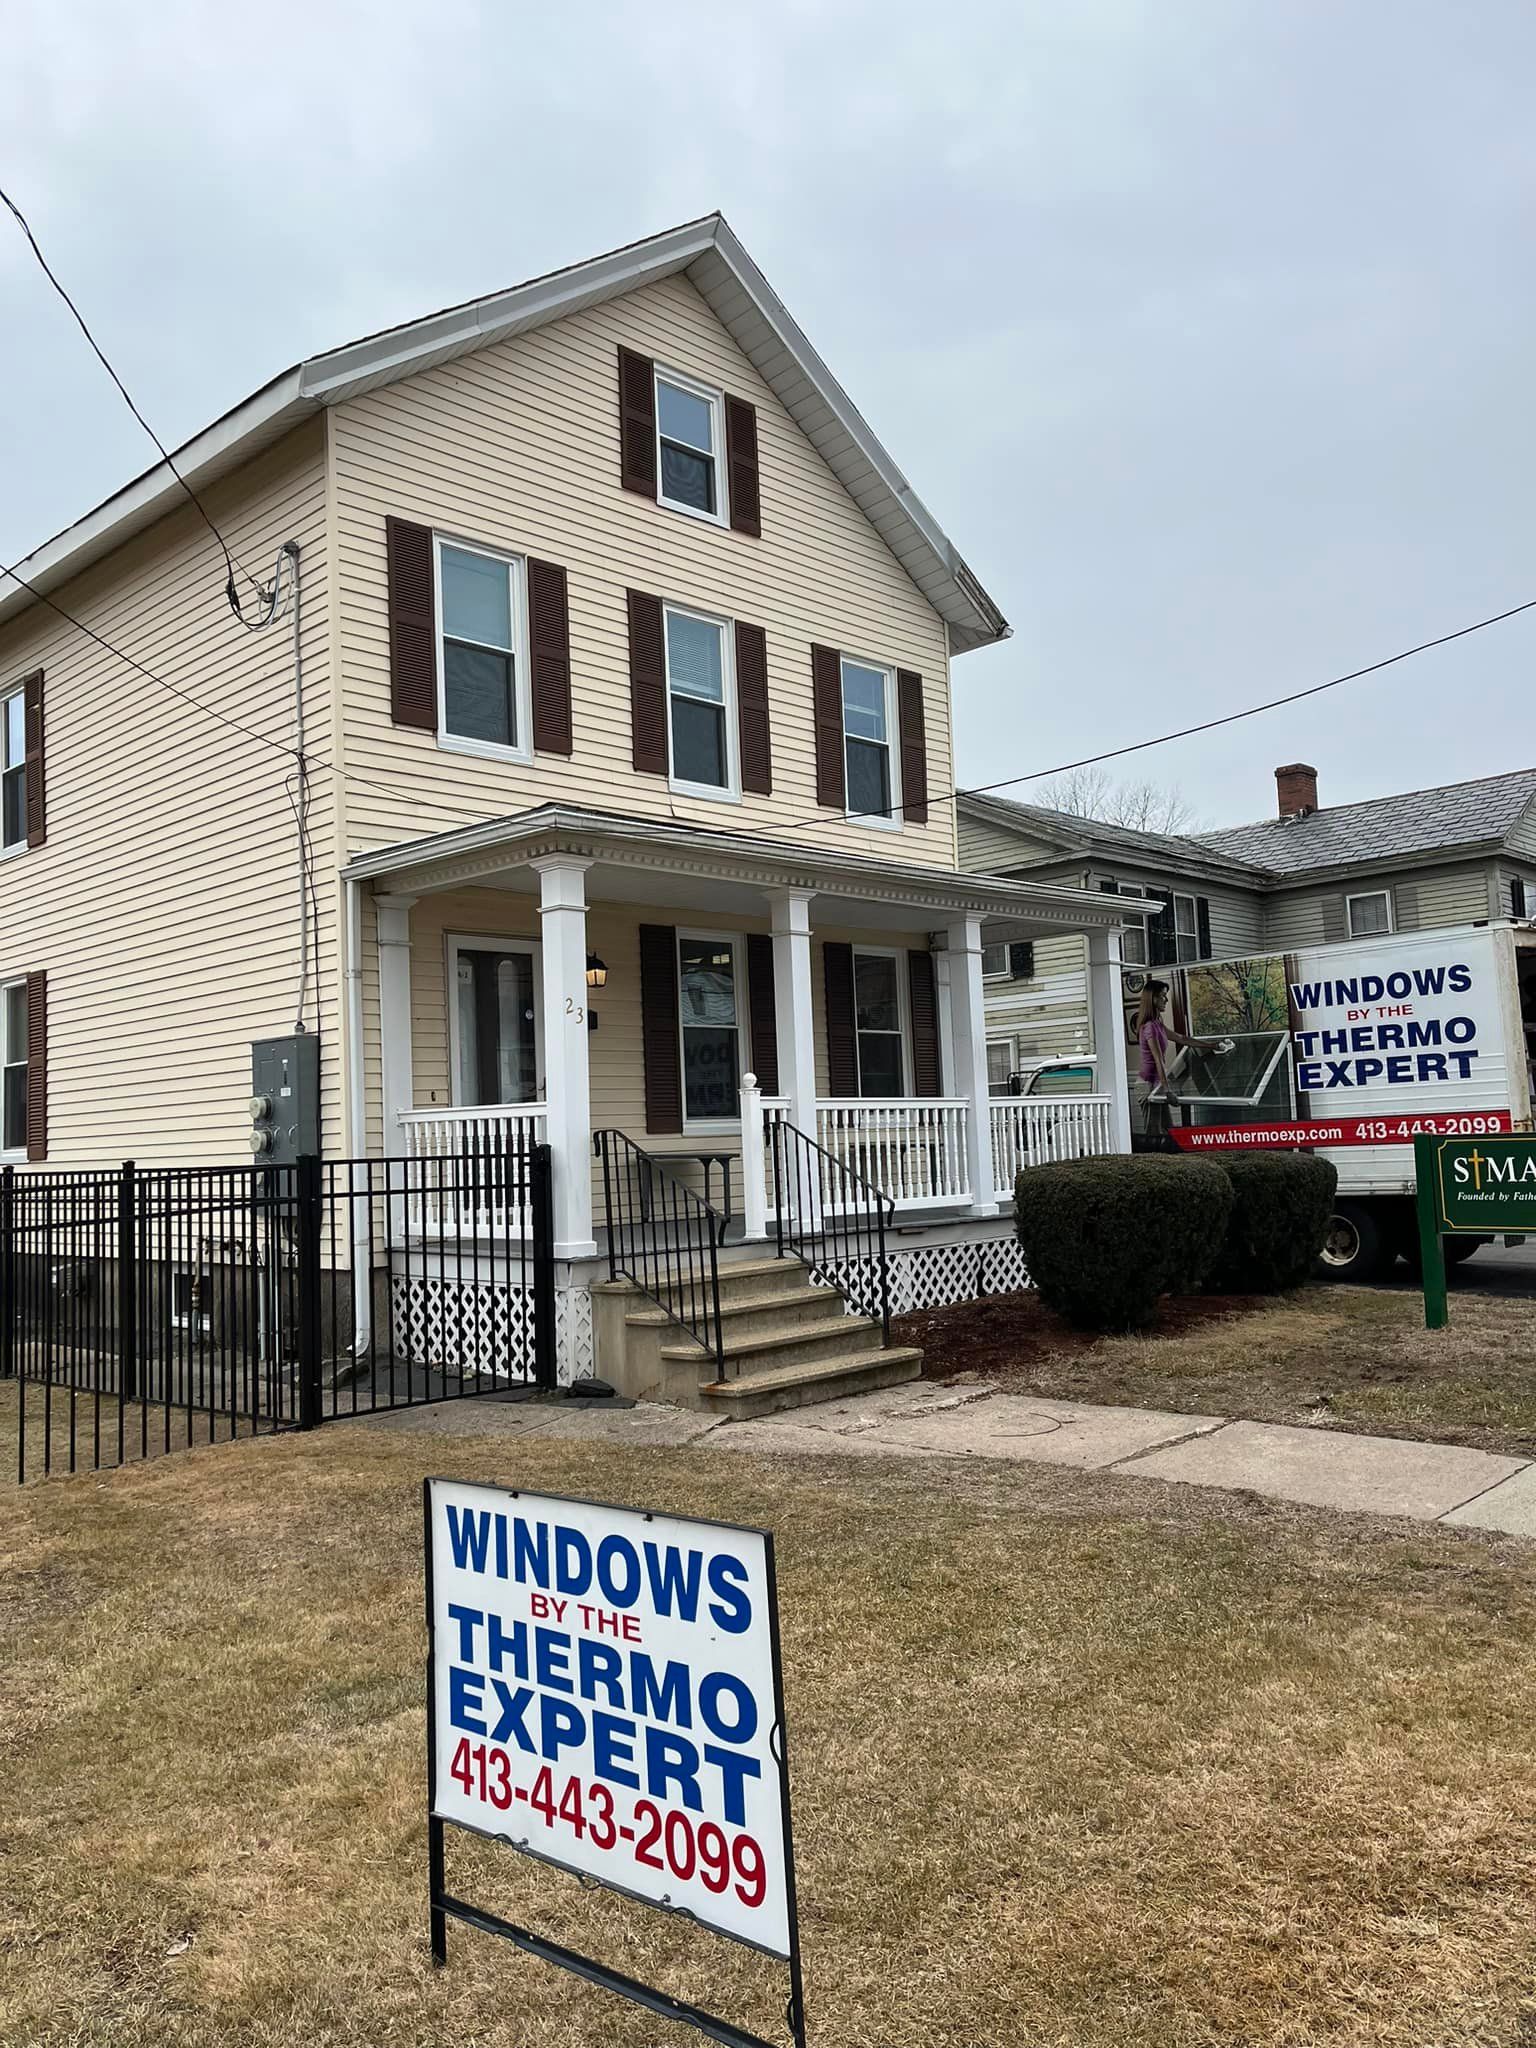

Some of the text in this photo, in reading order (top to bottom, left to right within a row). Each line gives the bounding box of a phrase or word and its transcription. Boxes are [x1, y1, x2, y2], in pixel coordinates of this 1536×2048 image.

[1292, 964, 1472, 1010] WINDOWS
[565, 997, 584, 1025] 23
[1347, 1004, 1414, 1021] BY THE
[1296, 1016, 1477, 1057] THERMO
[1300, 1049, 1479, 1090] EXPERT
[1191, 1116, 1501, 1145] www.thermoexp.com 413-443-2099
[1457, 1191, 1495, 1201] Founded
[1498, 1191, 1510, 1202] by
[445, 1504, 753, 1635] WINDOWS
[530, 1592, 643, 1643] BY THE
[447, 1602, 759, 1745] THERMO
[448, 1664, 762, 1828] EXPERT
[450, 1737, 767, 1908] 413-443-2099
